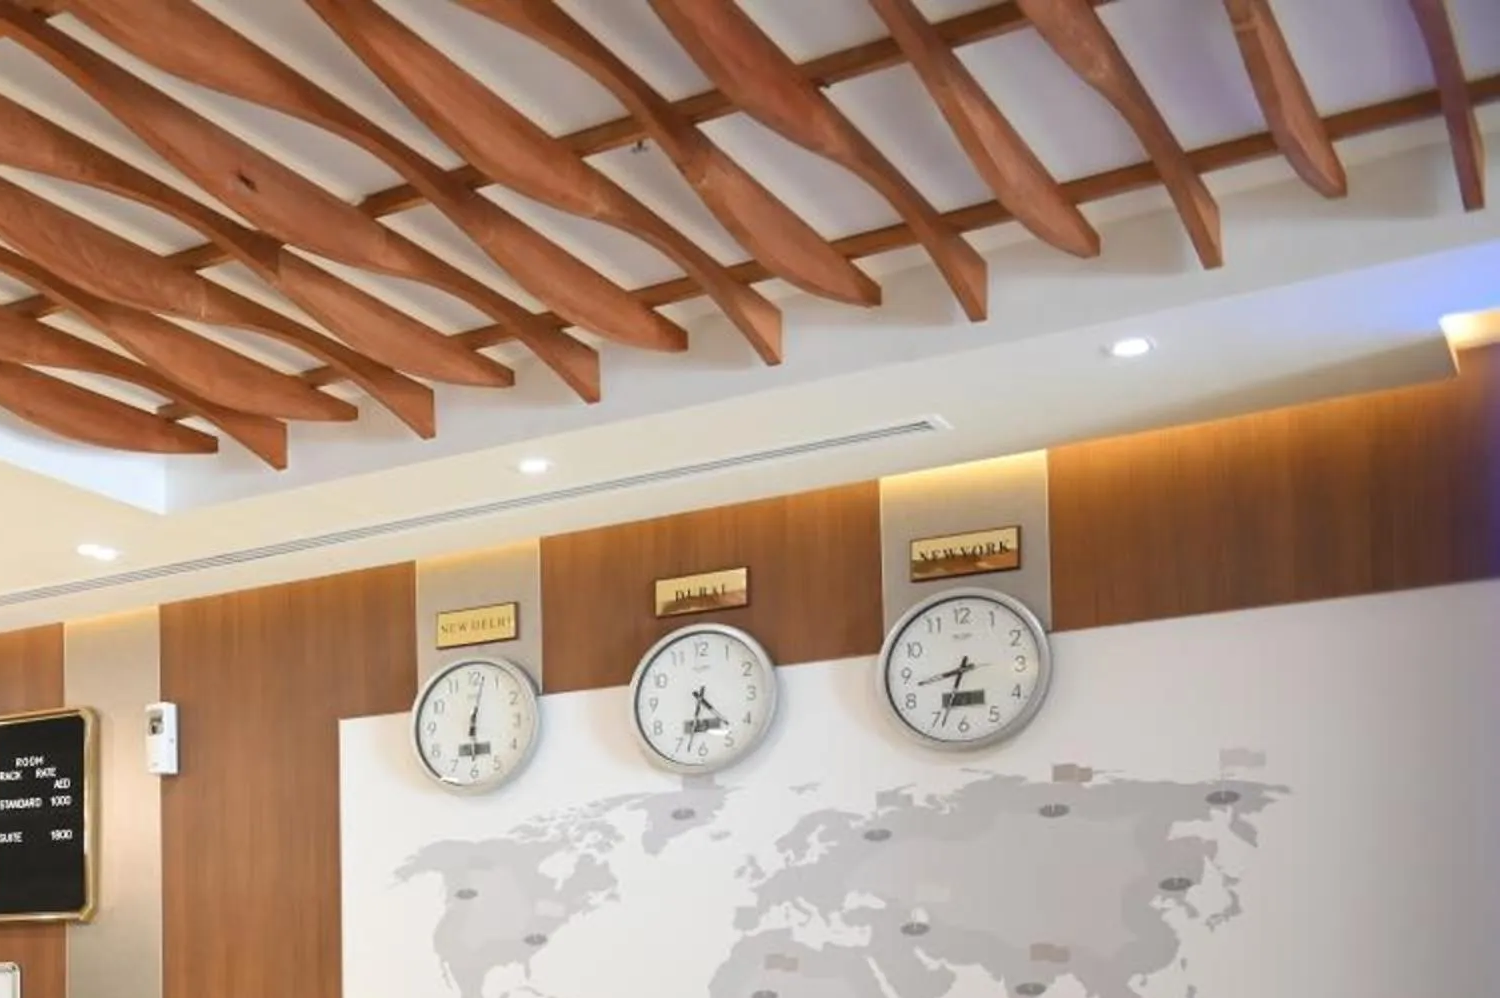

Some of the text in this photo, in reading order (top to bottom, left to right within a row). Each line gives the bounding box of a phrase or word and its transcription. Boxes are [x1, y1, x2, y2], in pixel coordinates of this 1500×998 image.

[954, 607, 971, 624] 12
[989, 611, 995, 628] 1
[927, 617, 941, 633] 11
[1010, 630, 1022, 647] 2
[694, 642, 709, 656] 12
[725, 645, 729, 661] 1
[907, 642, 922, 658] 10
[671, 651, 685, 665] 11
[1014, 655, 1026, 672] 3
[742, 662, 752, 677] 2
[901, 667, 911, 685] 9
[468, 671, 480, 685] 12
[494, 678, 499, 689] 1
[654, 673, 667, 689] 10
[448, 679, 458, 693] 11
[747, 686, 756, 701] 3
[1012, 683, 1021, 699] 4
[509, 692, 518, 705] 2
[650, 698, 657, 712] 9
[906, 693, 917, 709] 8
[434, 700, 445, 713] 10
[989, 706, 999, 722] 5
[514, 715, 520, 728] 3
[743, 711, 751, 724] 4
[932, 712, 941, 727] 7
[958, 716, 969, 733] 6
[427, 721, 436, 734] 9
[654, 720, 663, 734] 8
[511, 738, 517, 749] 4
[675, 738, 684, 753] 7
[725, 732, 734, 747] 5
[432, 744, 441, 757] 8
[698, 741, 708, 756] 6
[451, 760, 459, 773] 7
[470, 765, 479, 778] 6
[494, 757, 500, 771] 5
[0, 797, 42, 810] STANDARD
